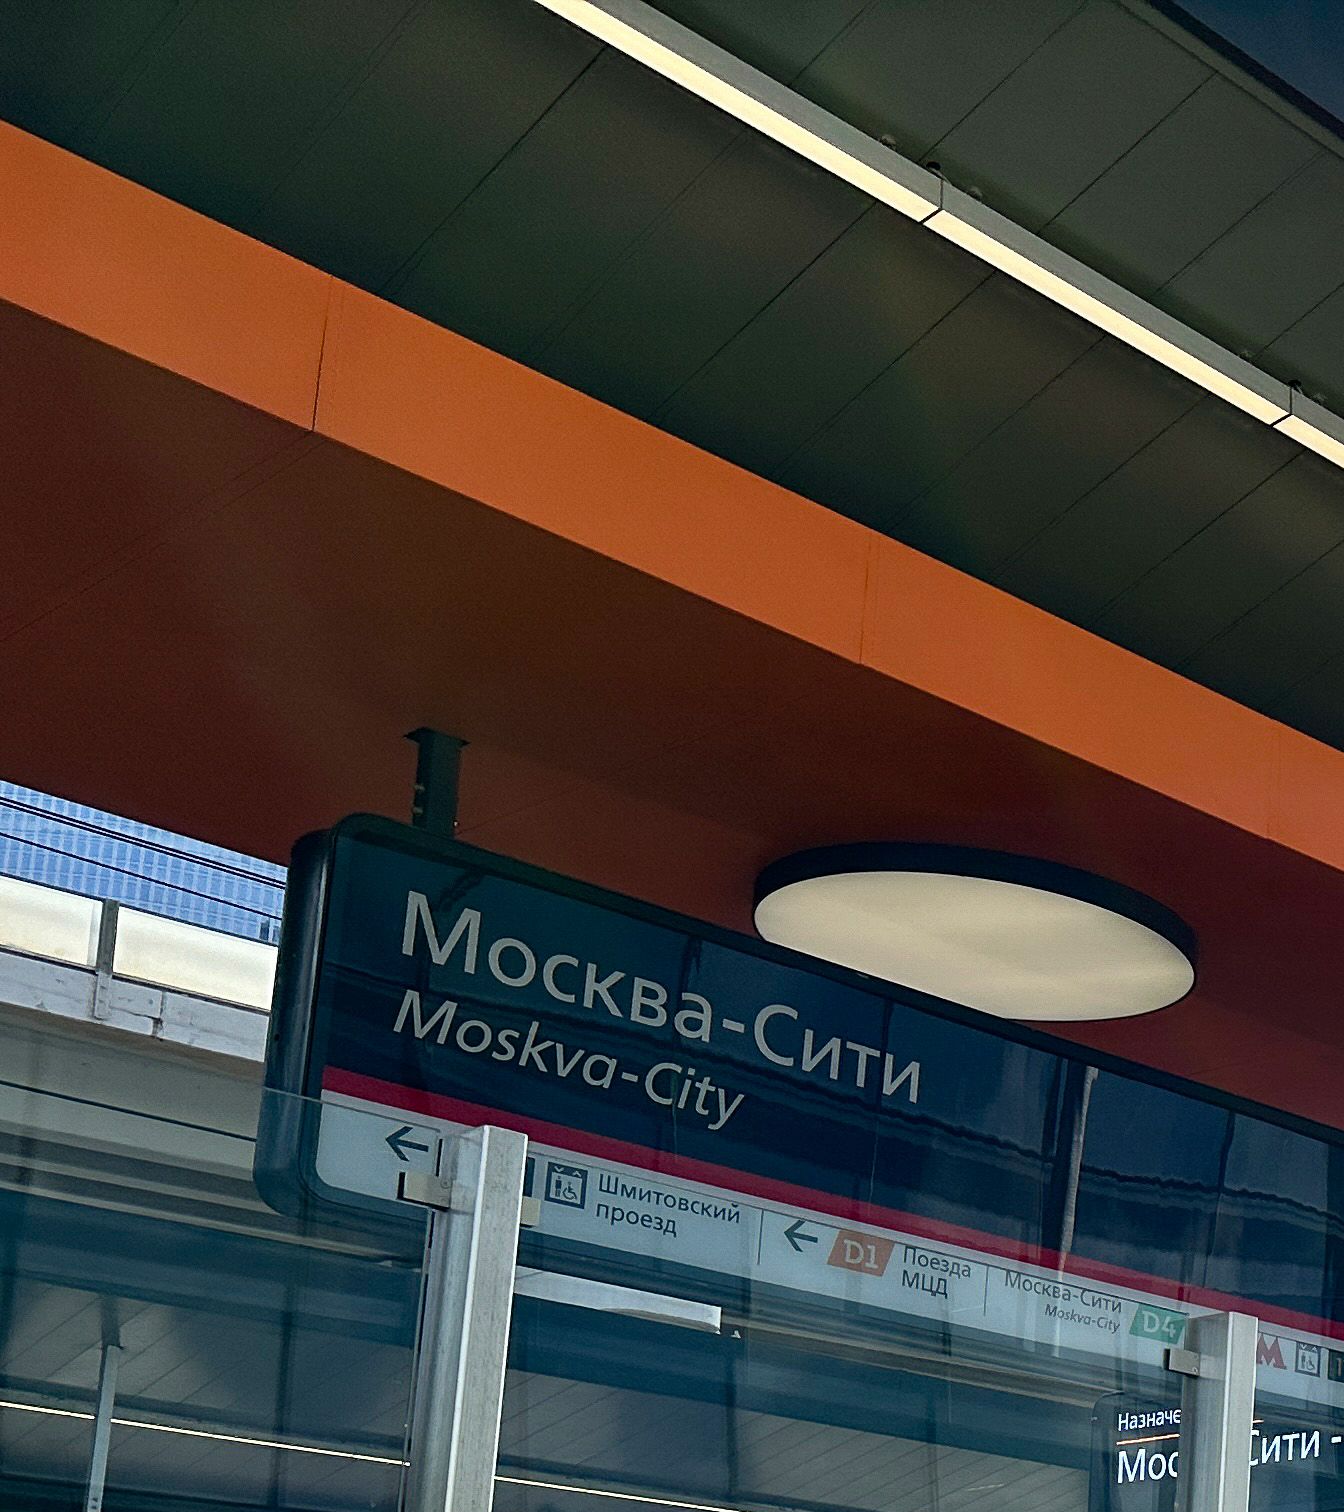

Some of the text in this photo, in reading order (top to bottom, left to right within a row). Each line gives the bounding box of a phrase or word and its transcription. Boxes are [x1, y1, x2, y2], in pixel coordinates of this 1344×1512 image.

[402, 890, 921, 1104] Москва-Сити
[393, 990, 745, 1131] Moskva-City
[598, 1173, 741, 1224] Шмитовский
[595, 1203, 677, 1238] проезд
[843, 1239, 879, 1269] D1
[903, 1246, 972, 1279] Поезда
[901, 1269, 948, 1300] МЦД
[1004, 1269, 1123, 1314] Москва-Сити
[1044, 1302, 1121, 1335] Moskva-City
[1142, 1310, 1177, 1338] D4
[1117, 1409, 1182, 1432] Назначе
